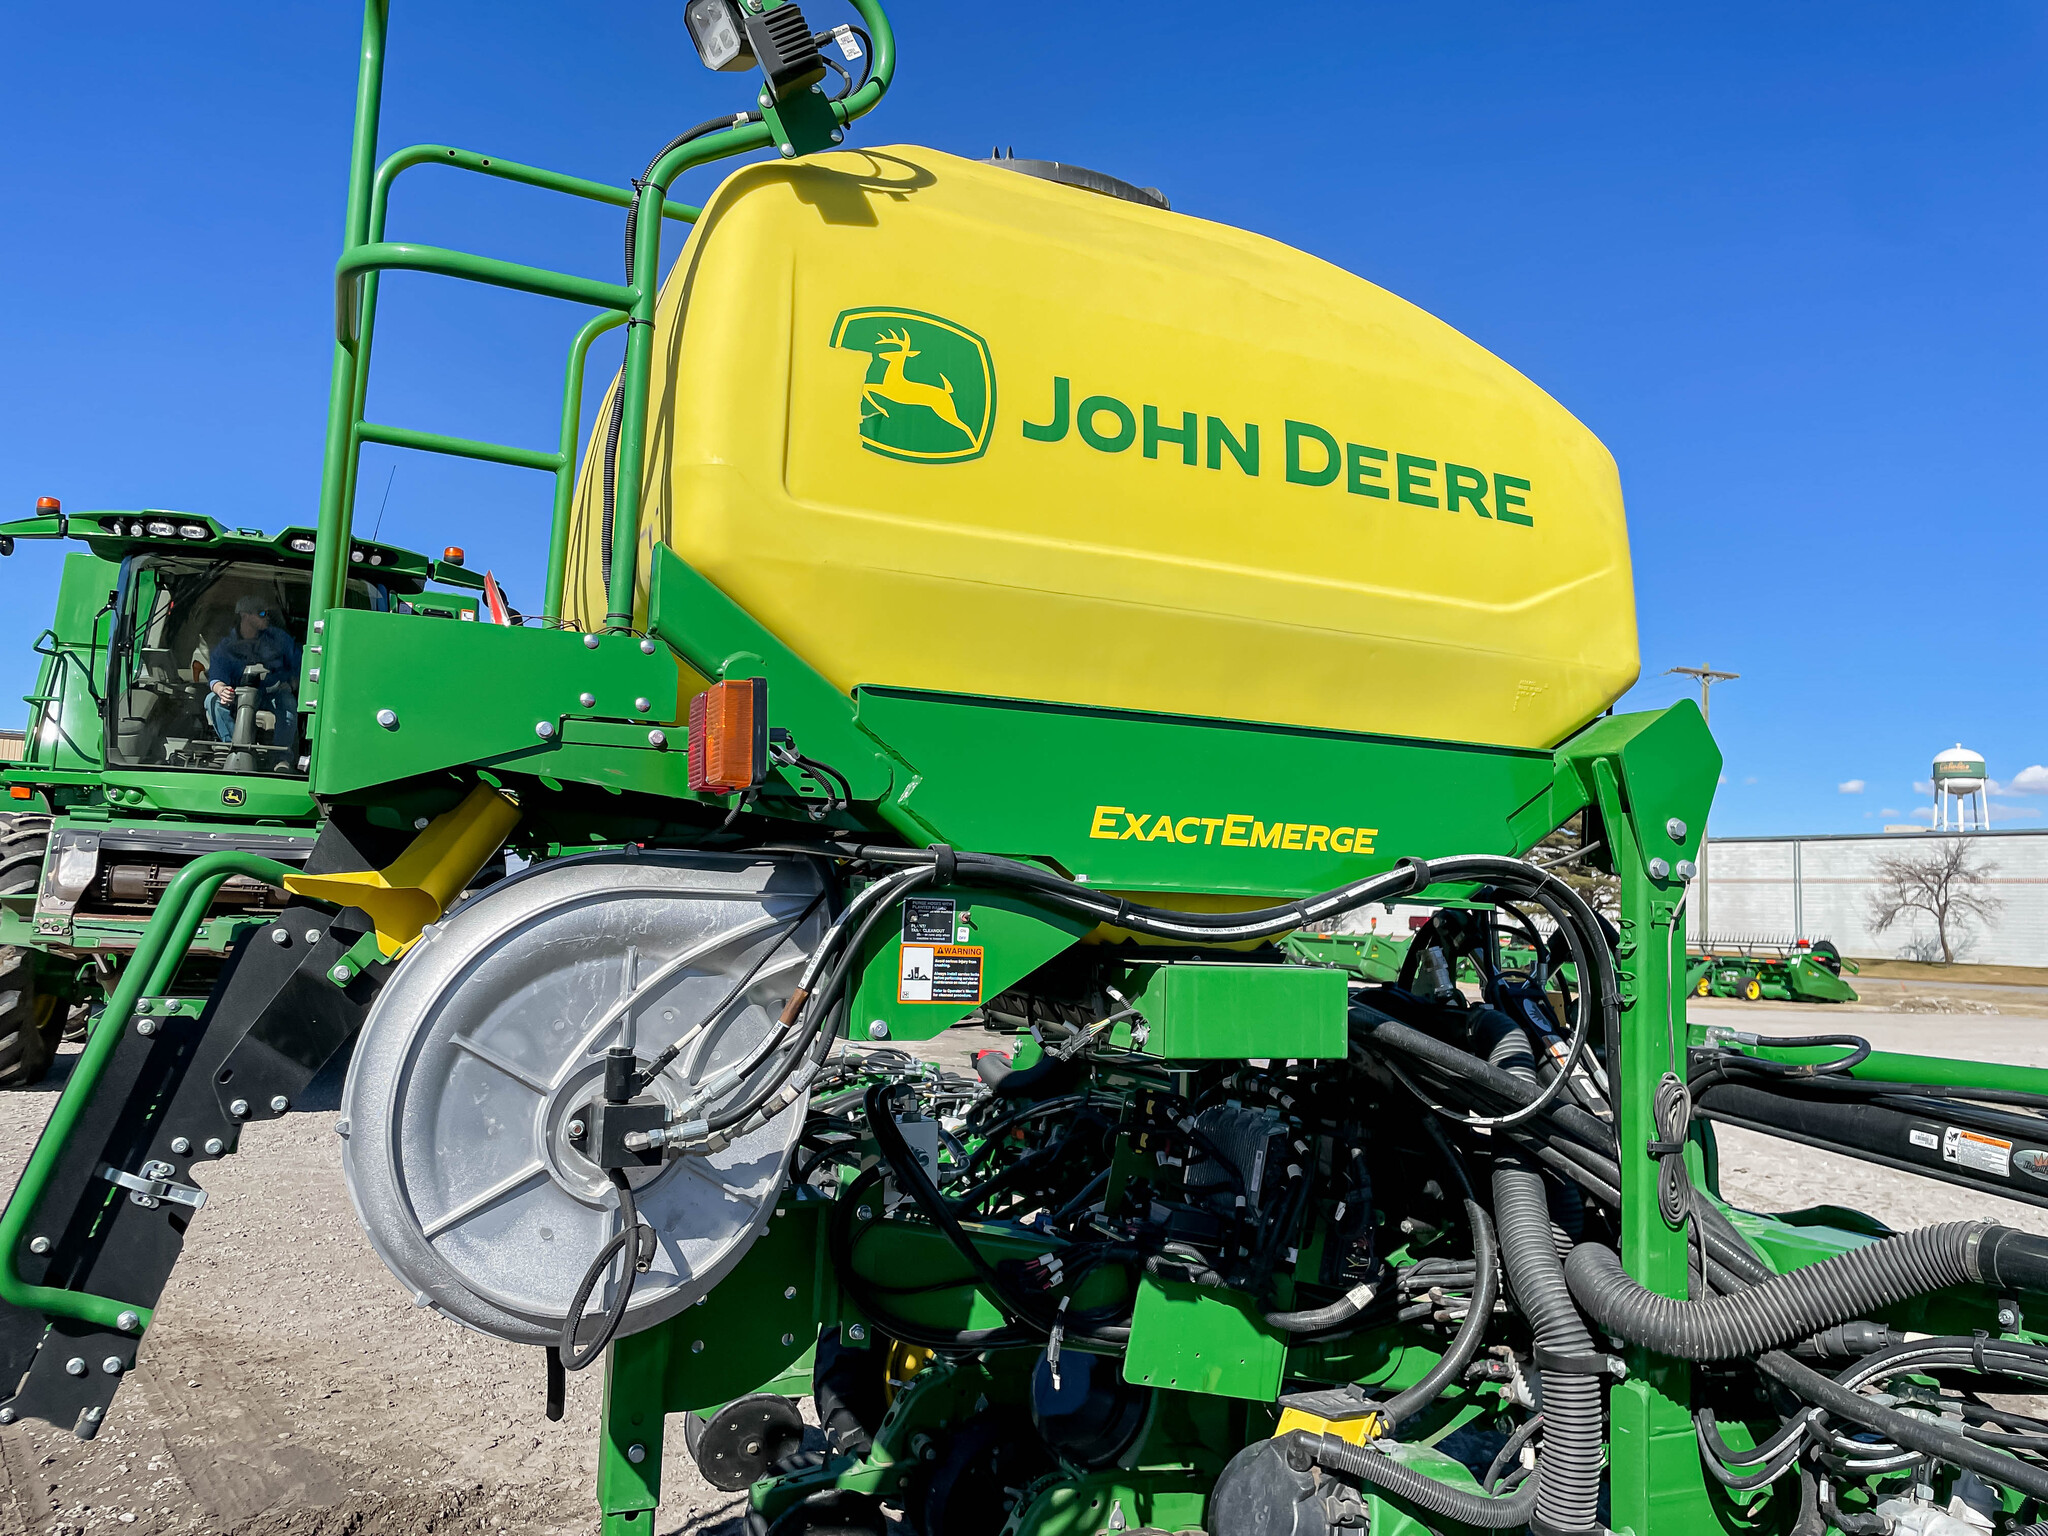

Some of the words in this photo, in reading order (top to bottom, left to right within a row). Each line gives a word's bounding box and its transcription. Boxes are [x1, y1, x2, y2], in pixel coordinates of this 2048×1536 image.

[1023, 376, 1260, 477] JOHN
[1285, 420, 1533, 528] DEERE
[1089, 805, 1379, 856] EXACTEMERGE
